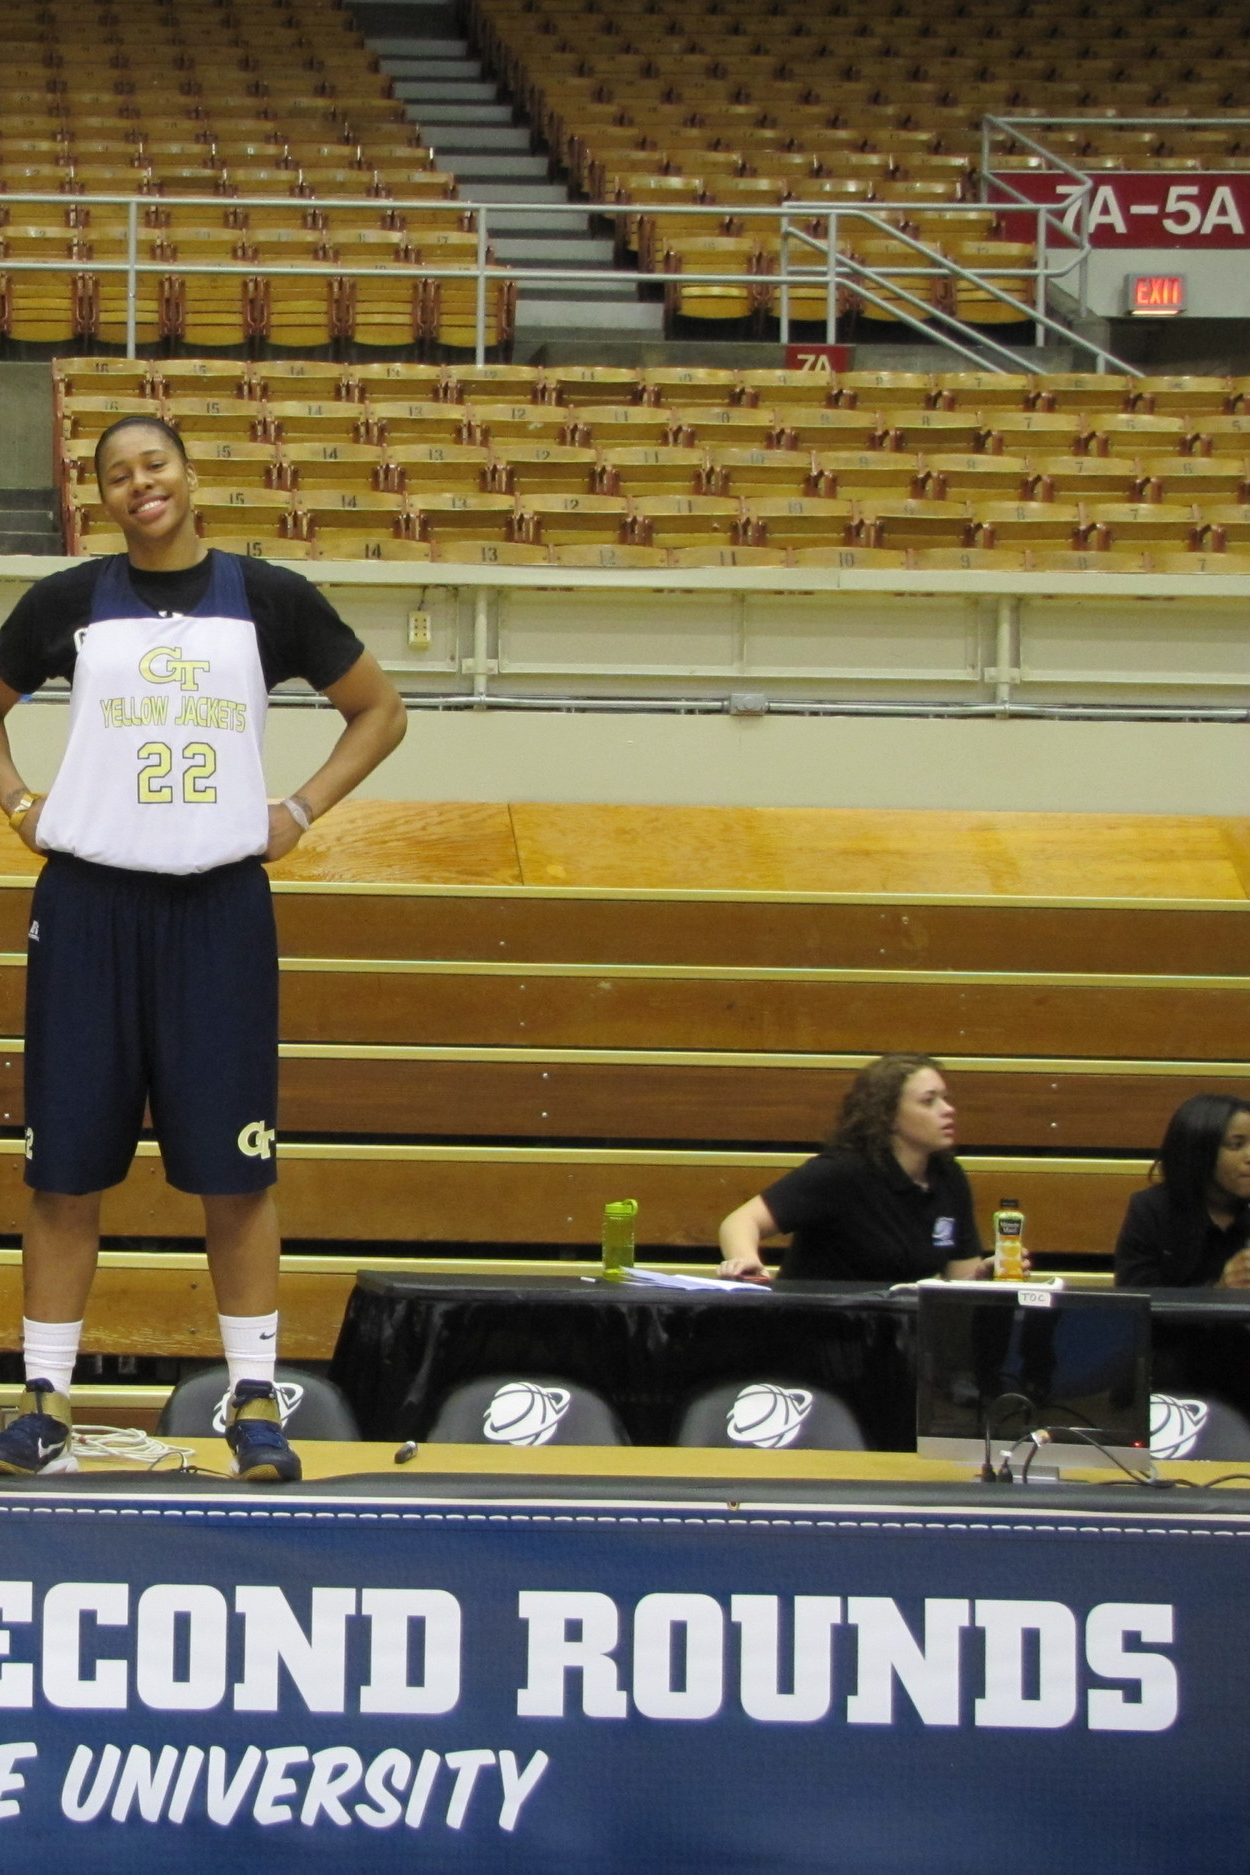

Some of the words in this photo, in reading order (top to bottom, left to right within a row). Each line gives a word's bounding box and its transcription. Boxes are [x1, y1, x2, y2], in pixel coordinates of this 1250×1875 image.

[1055, 185, 1245, 235] 7A-5A
[1136, 277, 1181, 305] EXIT
[797, 354, 832, 372] 7A
[974, 378, 982, 388] 7
[206, 403, 220, 414] 15
[511, 408, 526, 419] 12
[1023, 417, 1032, 429] 7
[322, 448, 338, 460] 14
[1075, 461, 1084, 473] 7
[229, 493, 245, 505] 15
[341, 495, 357, 508] 14
[1130, 509, 1139, 520] 7
[246, 542, 262, 557] 15
[365, 544, 381, 559] 14
[481, 547, 498, 562] 13
[720, 551, 735, 566] 11
[838, 552, 855, 567] 10
[961, 554, 971, 569] 9
[138, 646, 210, 691] GT
[99, 696, 169, 728] YELLOW
[174, 696, 247, 733] JACKETS
[137, 741, 217, 804] 22
[1021, 1293, 1045, 1302] TOC
[517, 1589, 1178, 1731] ROUNDS
[61, 1743, 549, 1832] UNIVERSITY
